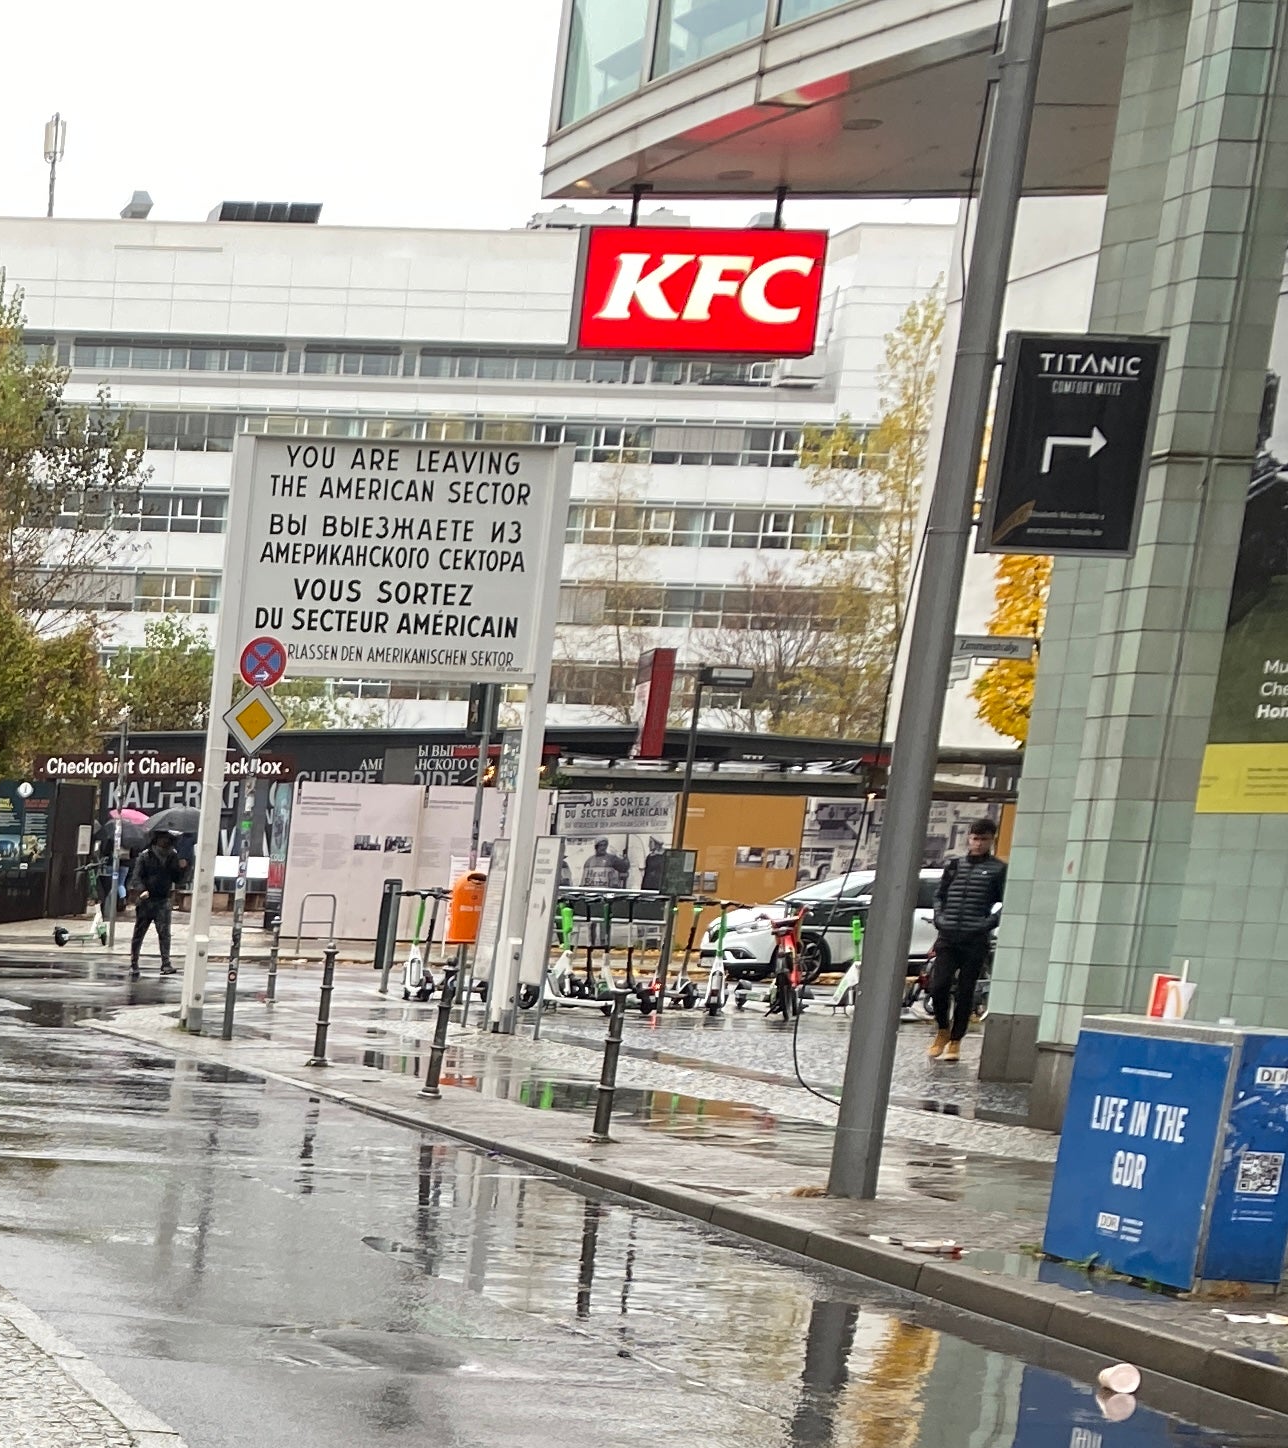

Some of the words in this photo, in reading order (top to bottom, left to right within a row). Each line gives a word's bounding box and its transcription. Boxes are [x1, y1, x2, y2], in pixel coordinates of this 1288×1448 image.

[592, 252, 816, 325] KFC
[1039, 353, 1142, 376] TITANIC
[1052, 380, 1093, 395] COMFORT
[1095, 381, 1123, 396] MITTE
[286, 444, 336, 469] YOU
[350, 448, 400, 472] ARE
[416, 450, 521, 475] LEAVING
[270, 474, 308, 498] THE
[319, 476, 435, 503] AMERICAN
[447, 481, 532, 506] SECTOR
[269, 513, 307, 537] ВЫ
[323, 515, 475, 542] ВЫЕЗЖАЕТЕ
[490, 520, 522, 544] ИЗ
[259, 541, 430, 570] АМЕРИКАНСКОГО
[439, 548, 526, 573] СЕКТОРА
[293, 577, 362, 603] VOUS
[376, 580, 475, 607] SORTEZ
[254, 607, 284, 630] DU
[291, 608, 390, 635] SECTEUR
[396, 610, 519, 639] AMÉRICAIN
[341, 645, 363, 662] DEN
[367, 645, 467, 666] AMERIKANISCHEN
[470, 650, 514, 668] SEKTOR
[138, 756, 195, 775] Charlie
[565, 809, 577, 819] DU
[581, 808, 618, 818] SECTEUR
[613, 796, 651, 807] SORTEZ
[1091, 1094, 1129, 1134] LIFE
[1128, 1100, 1152, 1138] IN
[1153, 1103, 1189, 1144] THE
[1111, 1150, 1147, 1190] GDR
